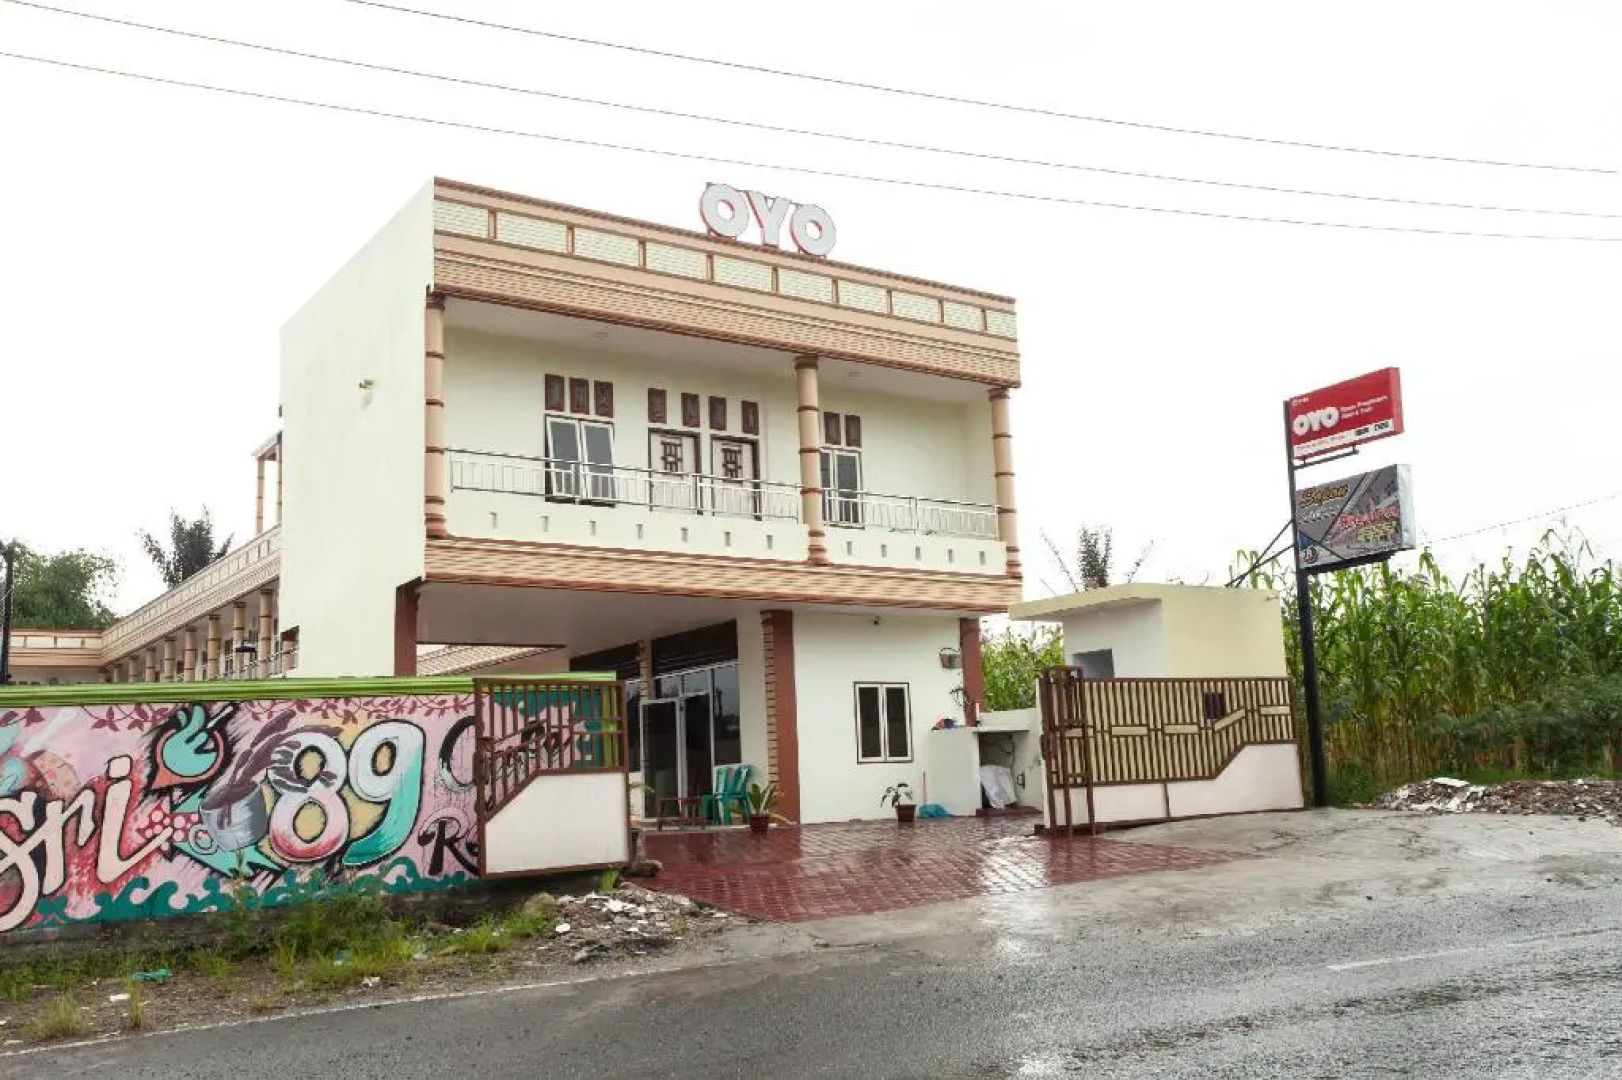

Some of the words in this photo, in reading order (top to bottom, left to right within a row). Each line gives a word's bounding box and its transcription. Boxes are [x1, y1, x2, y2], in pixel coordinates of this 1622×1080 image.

[700, 183, 836, 256] OYO
[1293, 406, 1339, 436] OYO
[267, 717, 427, 865] 89
